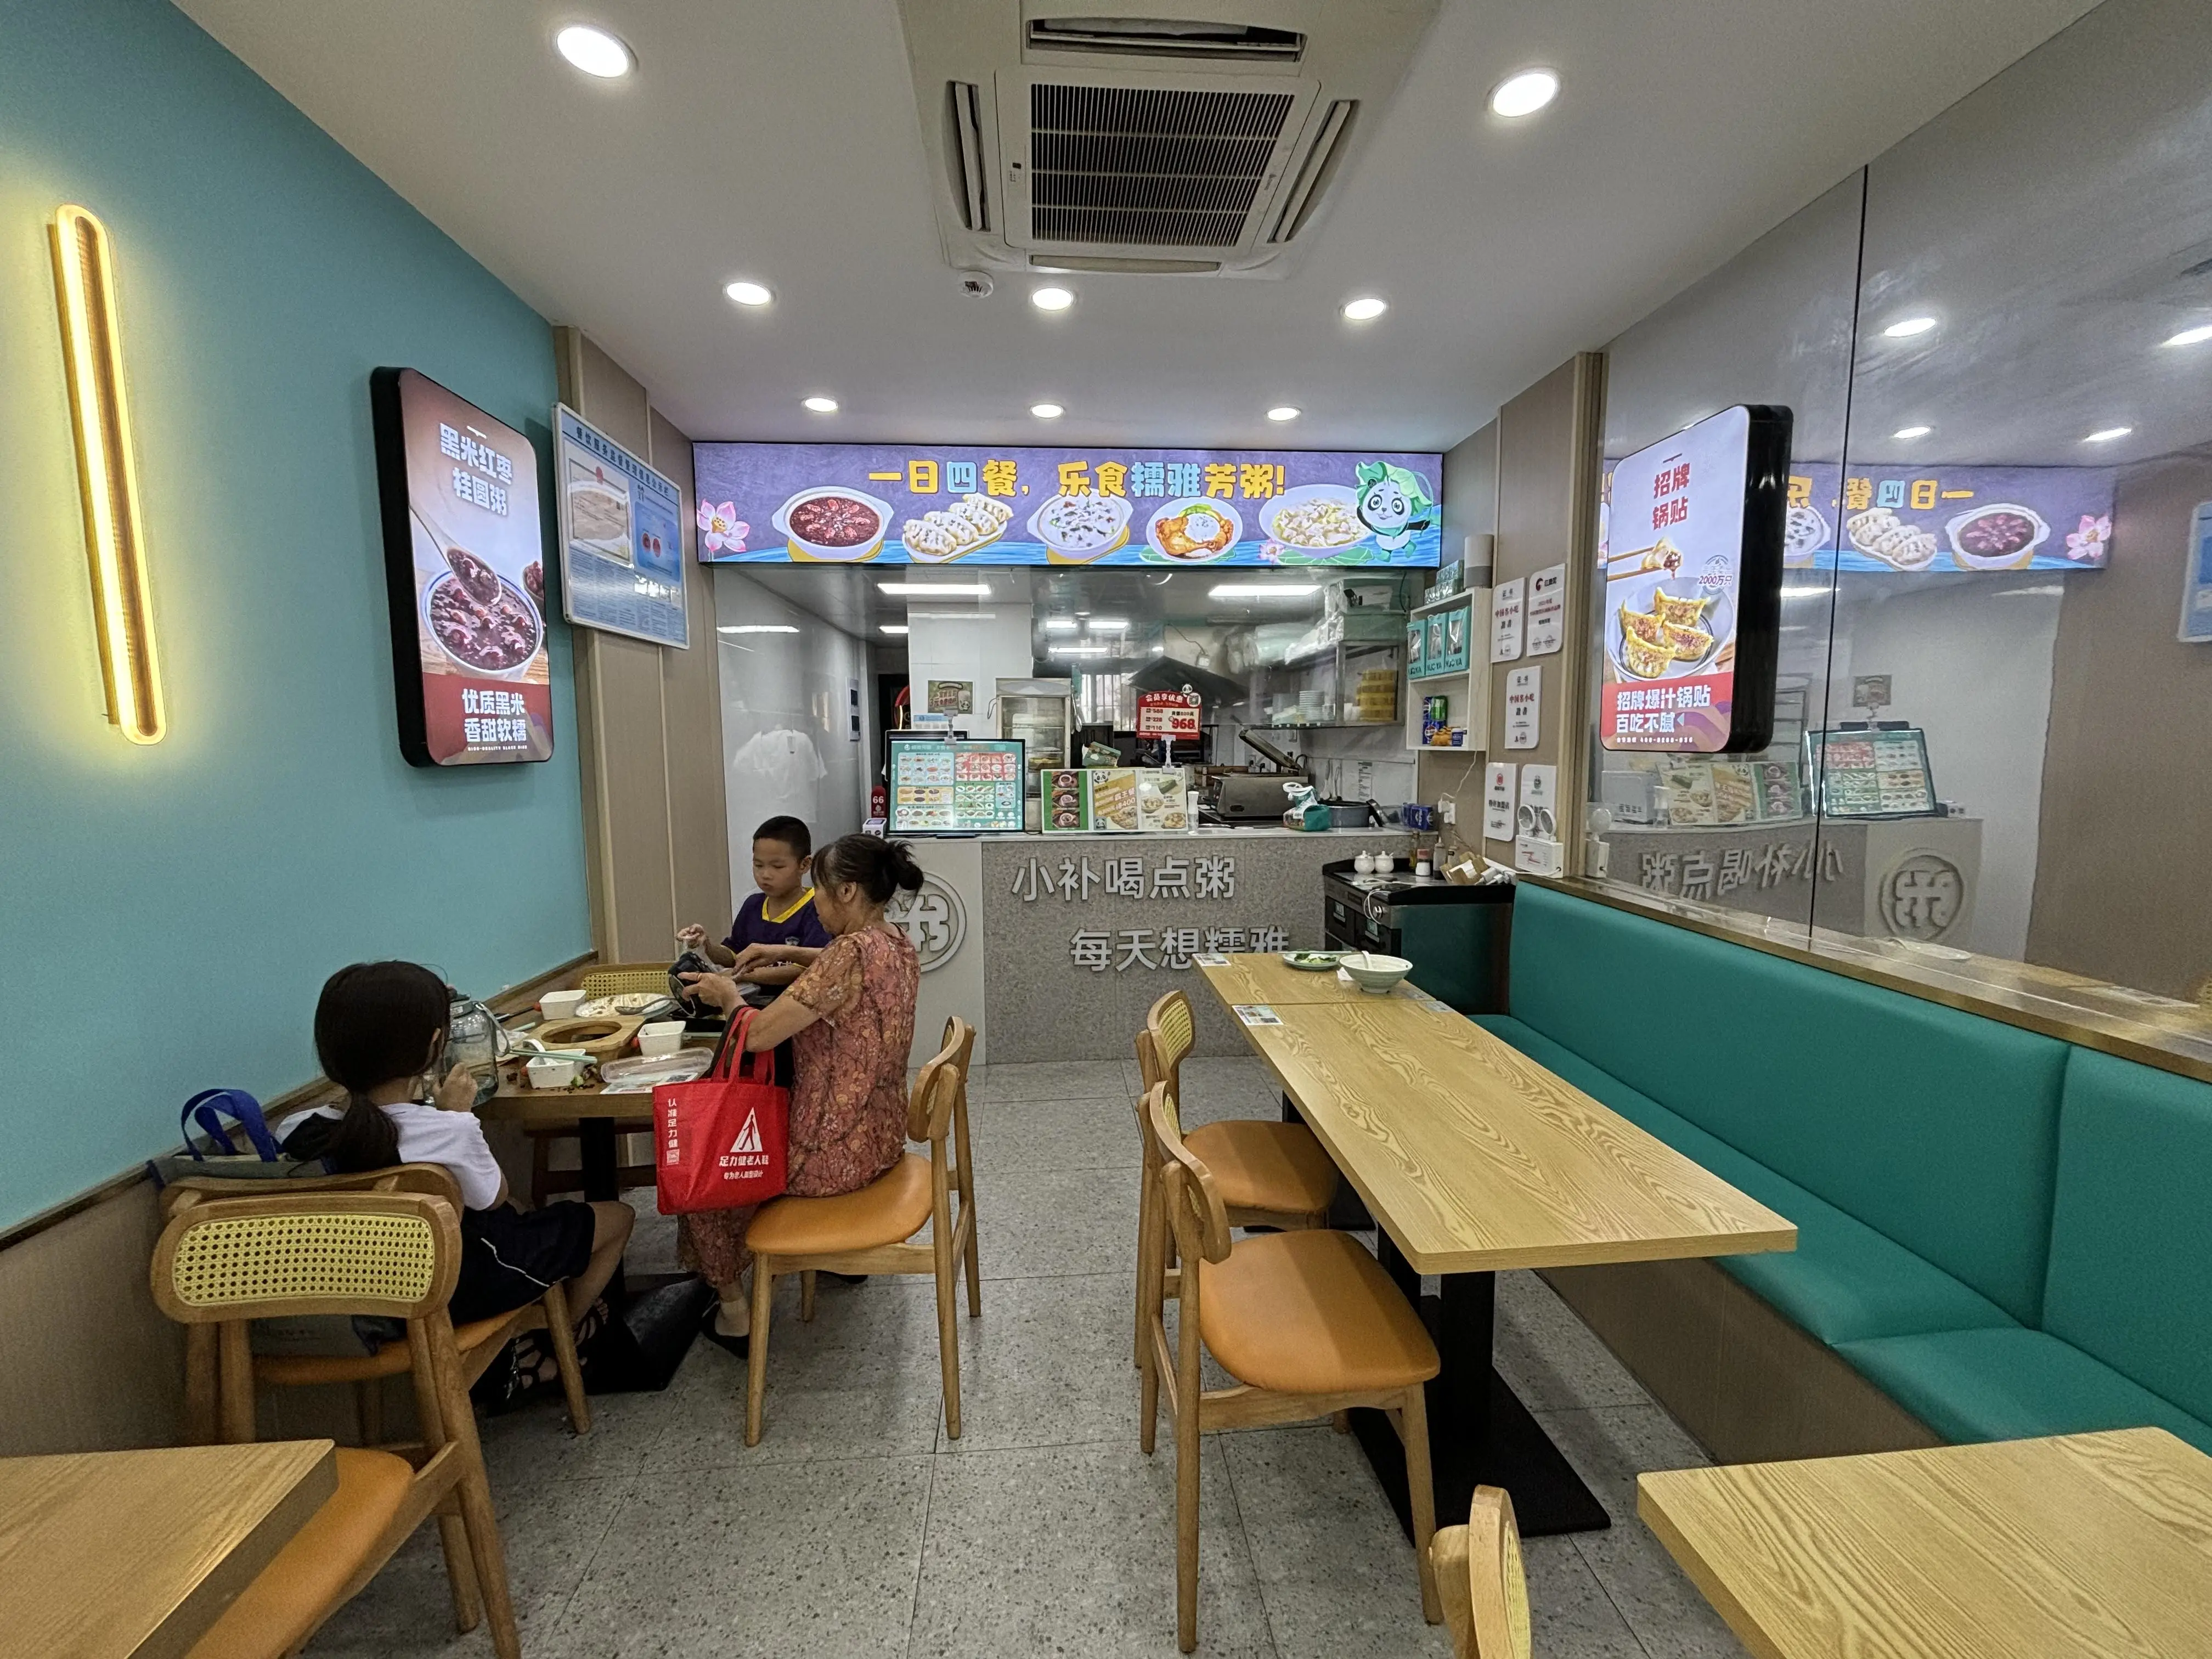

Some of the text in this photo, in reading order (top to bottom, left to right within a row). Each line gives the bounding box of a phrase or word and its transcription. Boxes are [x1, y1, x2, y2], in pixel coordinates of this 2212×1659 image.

[439, 422, 513, 485] 黑米红枣
[453, 467, 508, 516] 桂圆粥
[1654, 462, 1690, 499] 招牌
[1652, 496, 1688, 531] 锅贴
[1699, 575, 1733, 585] 2000万只
[461, 689, 525, 716] 优质黑米
[1617, 684, 1711, 712] 招牌爆汁锅贴
[464, 718, 527, 743] 香甜软糯
[1171, 718, 1195, 729] 968
[873, 795, 884, 804] 66
[1011, 855, 1235, 902] 小补喝点粥
[1070, 924, 1289, 972] 每天想糯雅
[668, 1098, 678, 1148] 认准足力健
[719, 1155, 769, 1167] 足力健老人鞋
